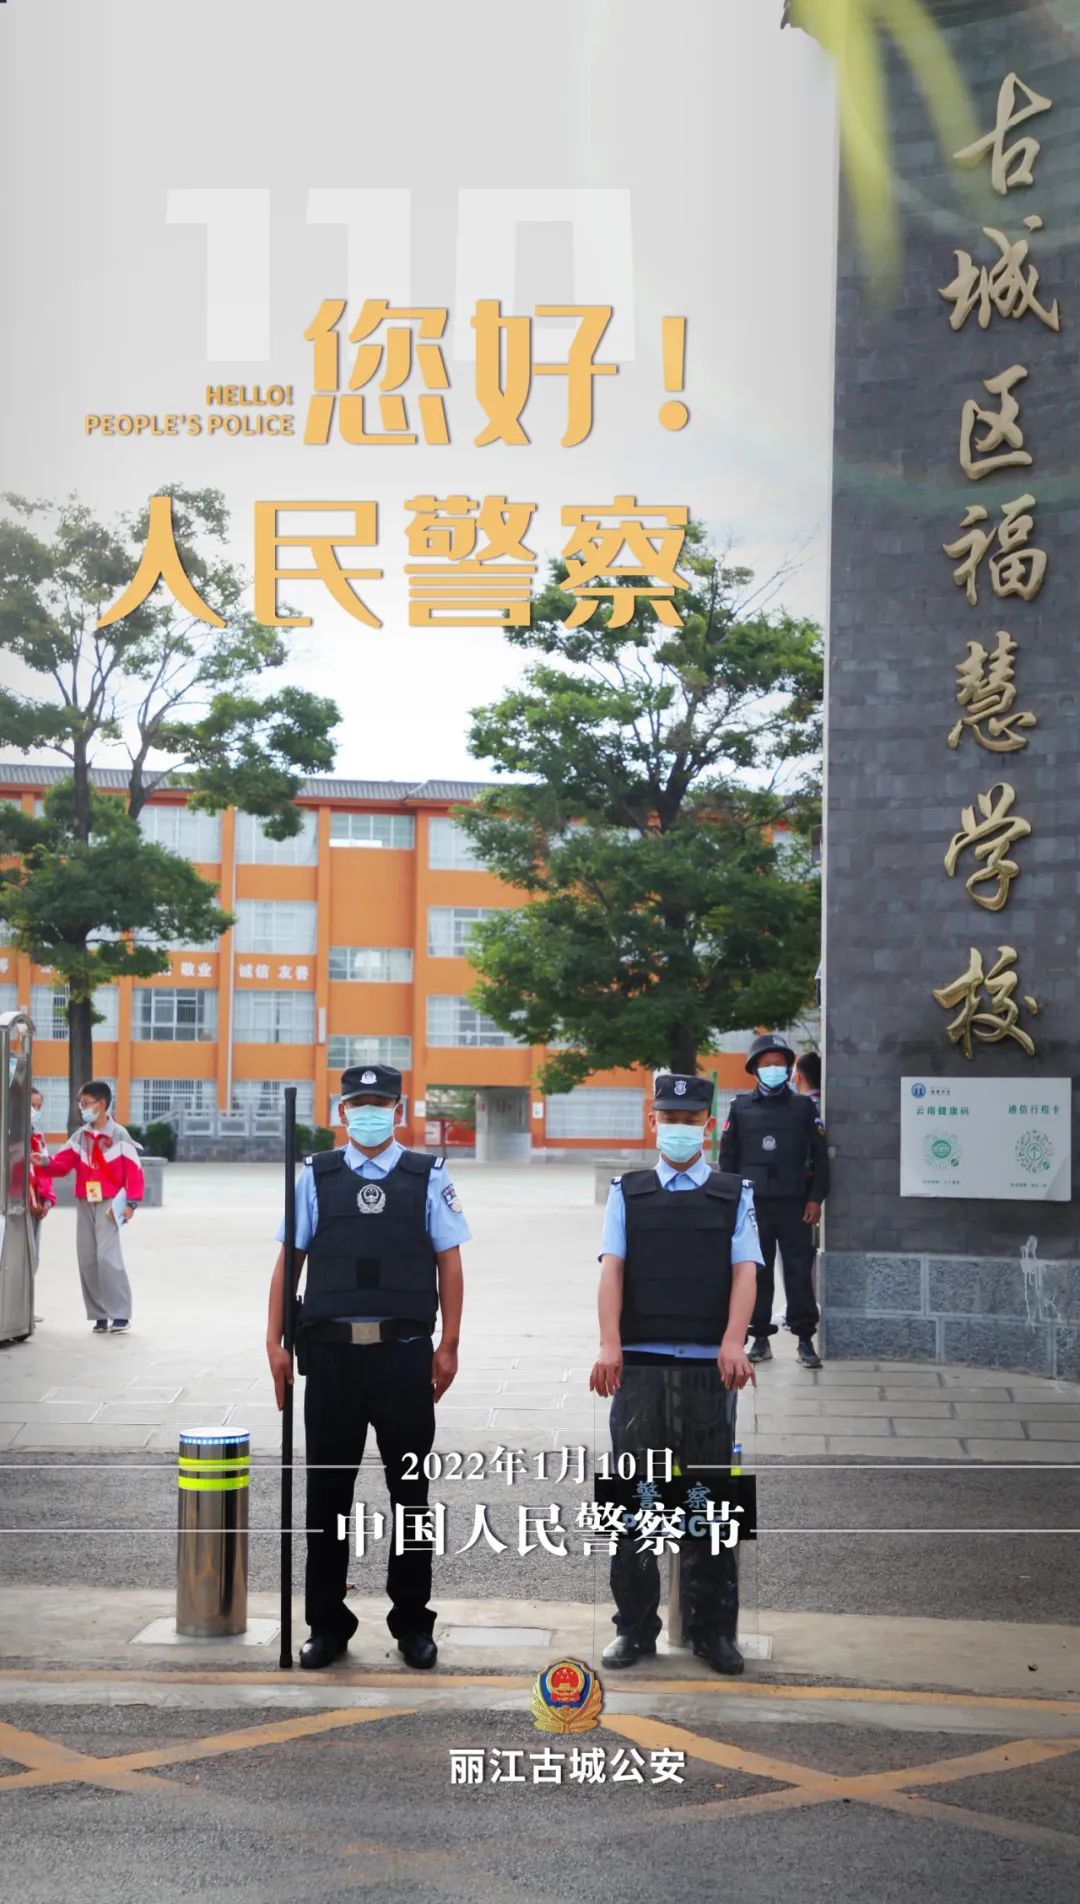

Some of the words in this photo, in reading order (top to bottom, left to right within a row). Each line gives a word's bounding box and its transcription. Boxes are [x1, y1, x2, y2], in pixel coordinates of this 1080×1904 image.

[939, 72, 1061, 1060] 古城区福慧学校
[915, 1105, 970, 1116] 云南健康码
[1008, 1104, 1061, 1115] 通信行程卡
